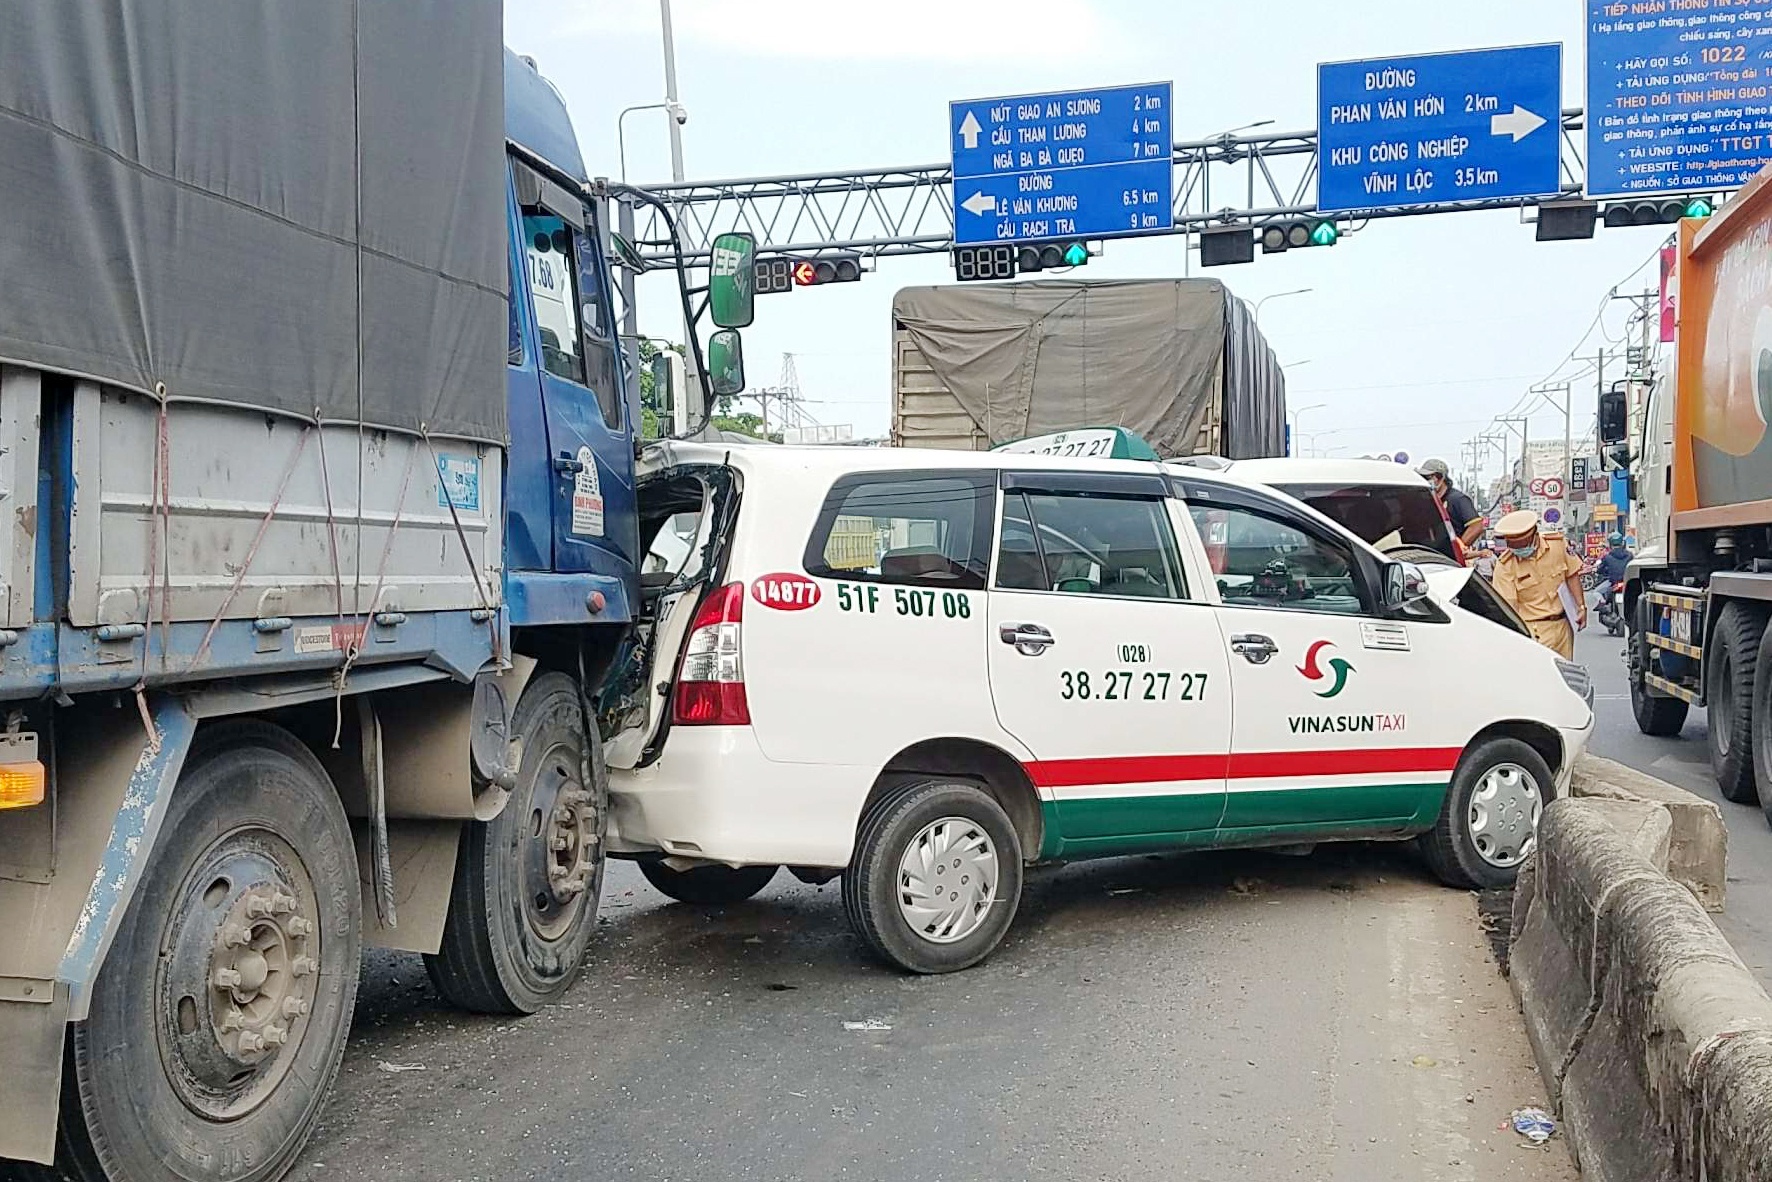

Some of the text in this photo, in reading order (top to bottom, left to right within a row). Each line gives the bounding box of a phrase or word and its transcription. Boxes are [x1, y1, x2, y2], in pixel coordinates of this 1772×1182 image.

[1650, 56, 1669, 70] GỌI
[1702, 46, 1746, 64] 1022
[1365, 66, 1416, 91] ĐƯỜNG
[991, 102, 1012, 123] NÚT
[1018, 102, 1041, 121] GIAO
[1046, 101, 1061, 119] AN
[1134, 96, 1141, 111] 2
[1145, 96, 1162, 110] km
[1616, 96, 1647, 108] THEO
[1738, 86, 1766, 99] GIAO
[1331, 103, 1371, 124] PHAN
[1378, 97, 1407, 120] VĂN
[1744, 106, 1768, 116] theo
[992, 126, 1012, 146] CẦU
[1018, 126, 1046, 144] THAM
[1133, 120, 1139, 134] 4
[1144, 119, 1160, 133] km
[994, 142, 1160, 170] NGÃ BA BÀ QUẸO 7 km
[1331, 134, 1469, 166] KHU CÔNG NGHIỆP
[1019, 174, 1053, 192] ĐƯỜNG
[1364, 172, 1397, 194] VĨNH
[1406, 168, 1434, 194] LỘC
[1682, 176, 1702, 185] GIAO
[1705, 172, 1735, 184] THÔNG
[996, 198, 1008, 216] LÊ
[1122, 189, 1139, 206] 6.5
[1142, 189, 1158, 204] km
[997, 212, 1158, 240] CẦU RẠCH TRA 9 km
[1089, 438, 1111, 457] 27
[1548, 484, 1558, 492] 50
[756, 580, 816, 604] 14877
[837, 584, 880, 614] 51F
[1116, 644, 1152, 664] (028)
[1060, 671, 1208, 701] 38.27 27 27
